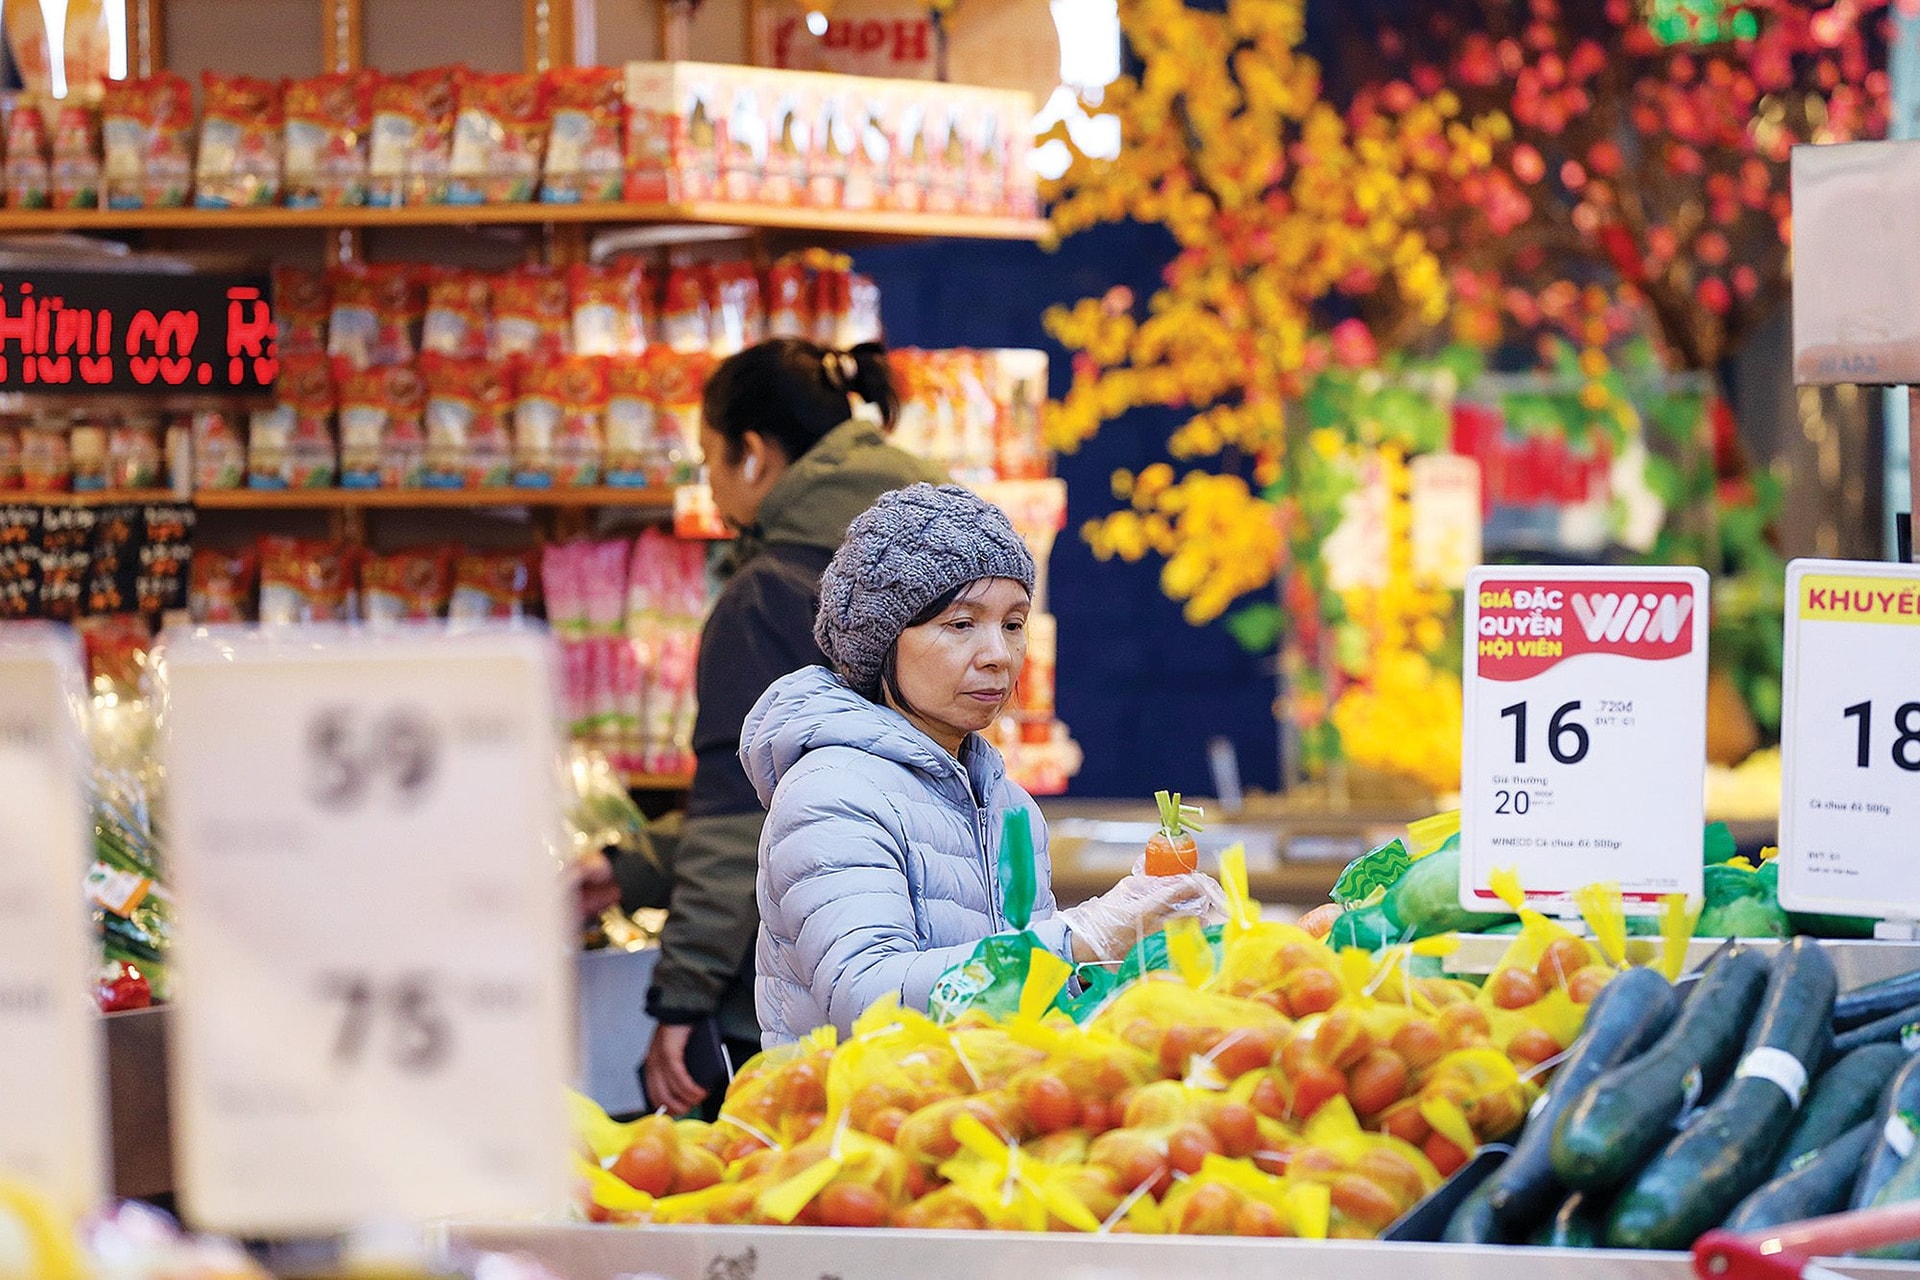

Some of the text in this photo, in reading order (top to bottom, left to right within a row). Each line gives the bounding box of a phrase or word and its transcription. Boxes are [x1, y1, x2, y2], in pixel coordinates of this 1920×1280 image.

[1479, 586, 1563, 611] GIÁ ĐẶC
[1479, 609, 1562, 636] QUYỀN
[1479, 637, 1562, 660] HỘI VIÊN
[1500, 700, 1590, 764] 16
[1843, 700, 1920, 772] 18
[1495, 790, 1530, 815] 20
